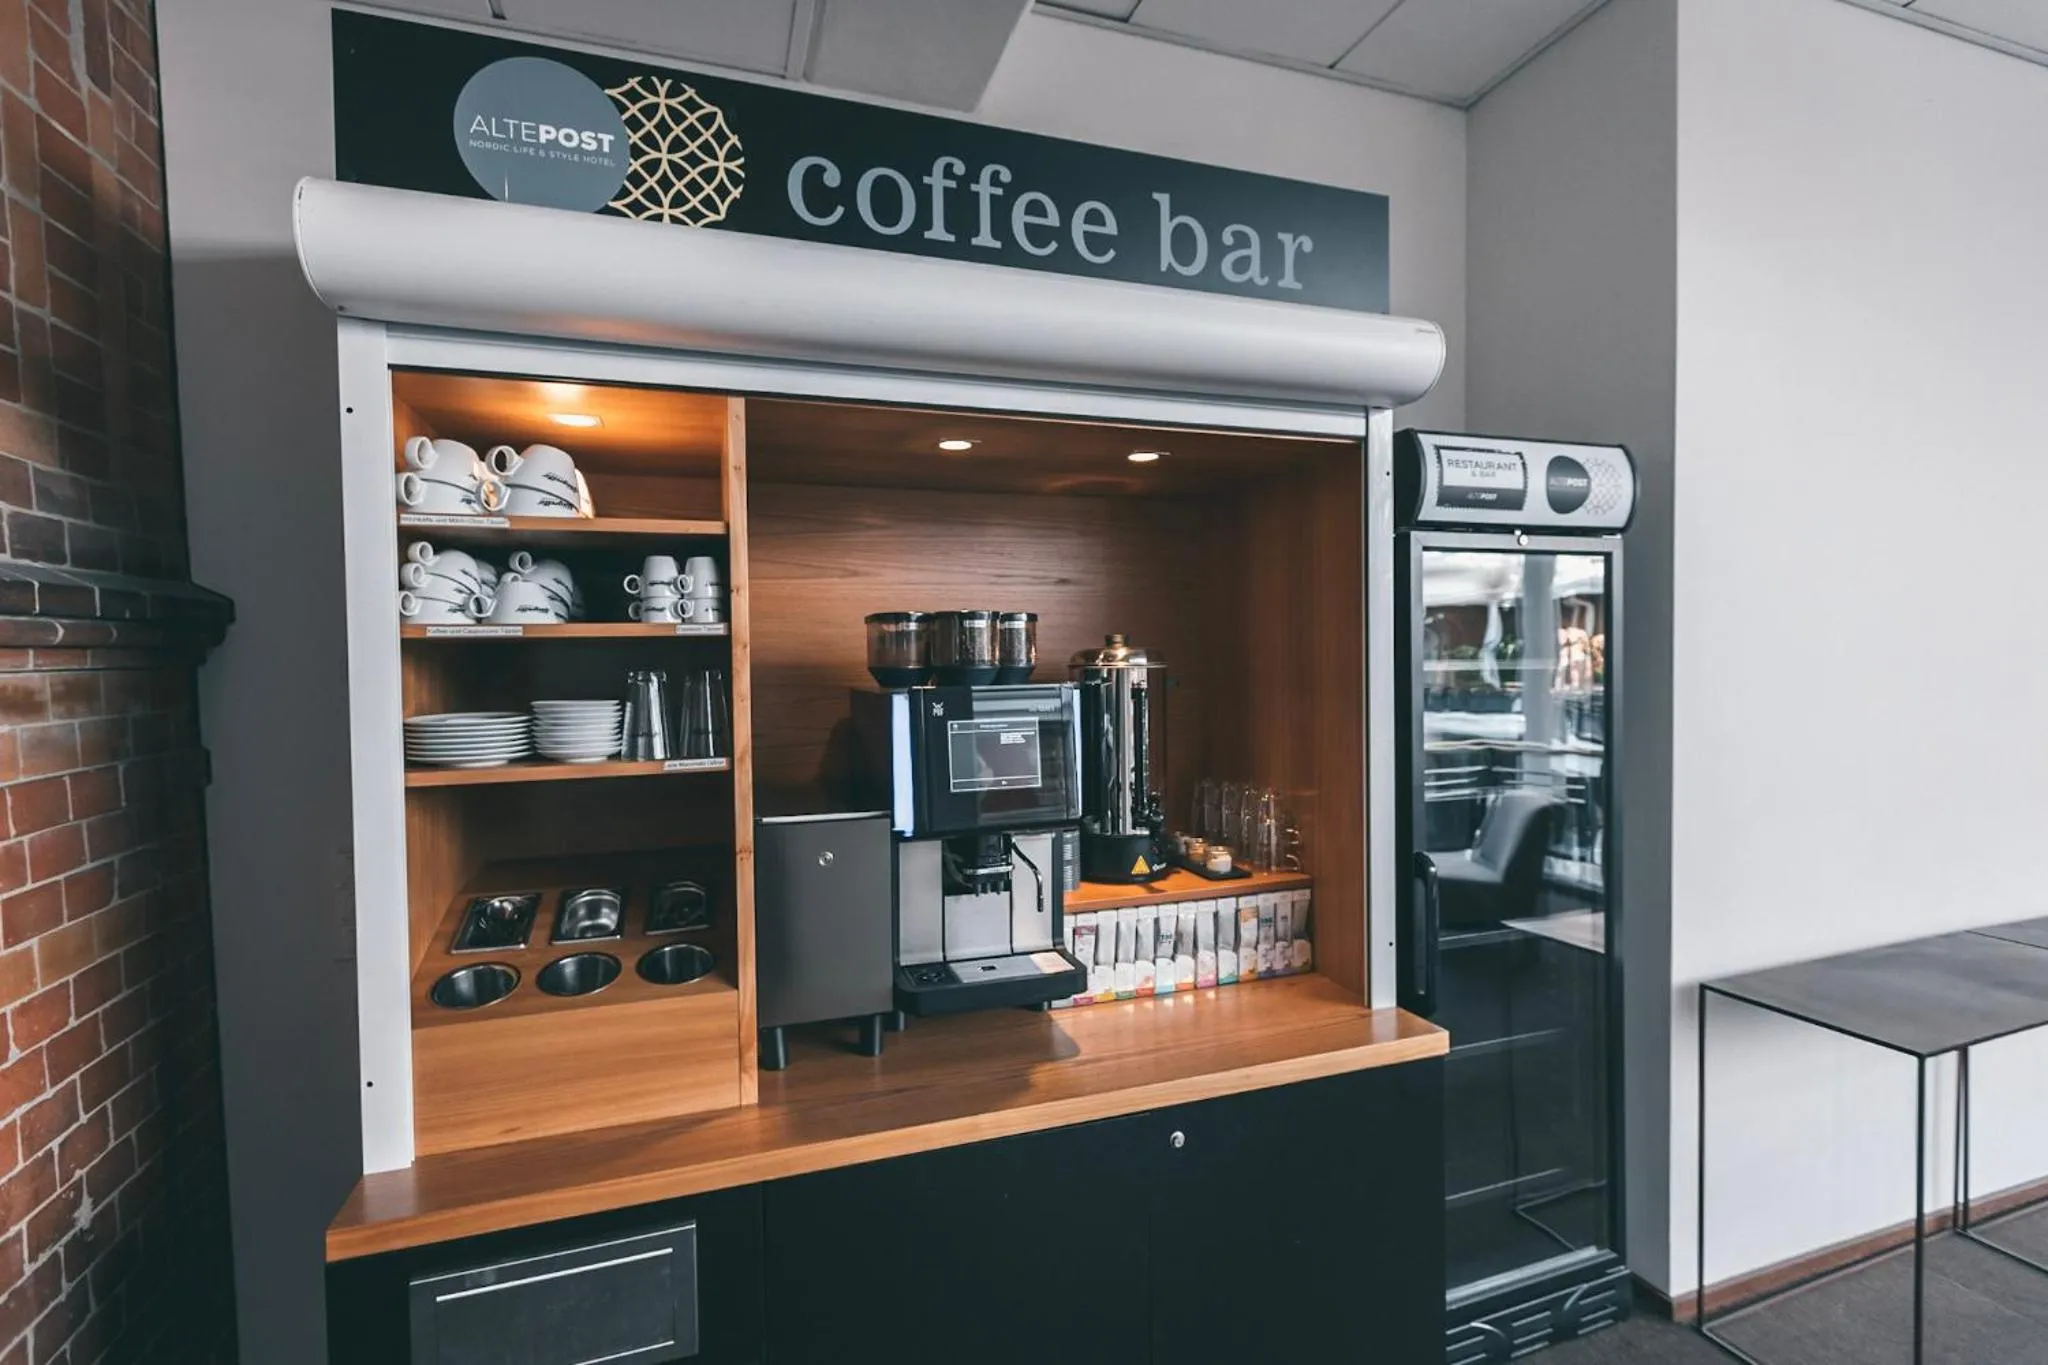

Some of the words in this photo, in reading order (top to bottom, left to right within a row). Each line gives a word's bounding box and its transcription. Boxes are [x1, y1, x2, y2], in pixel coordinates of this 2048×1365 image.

[469, 114, 615, 153] ALTEPOST
[469, 139, 510, 152] NORDIC
[513, 145, 537, 156] LIFE
[539, 149, 546, 158] &
[550, 150, 580, 162] STYLE
[583, 155, 616, 167] HOTEL
[787, 156, 1118, 264] coffee
[1152, 192, 1313, 290] bar
[1447, 458, 1518, 471] RESTAURANT
